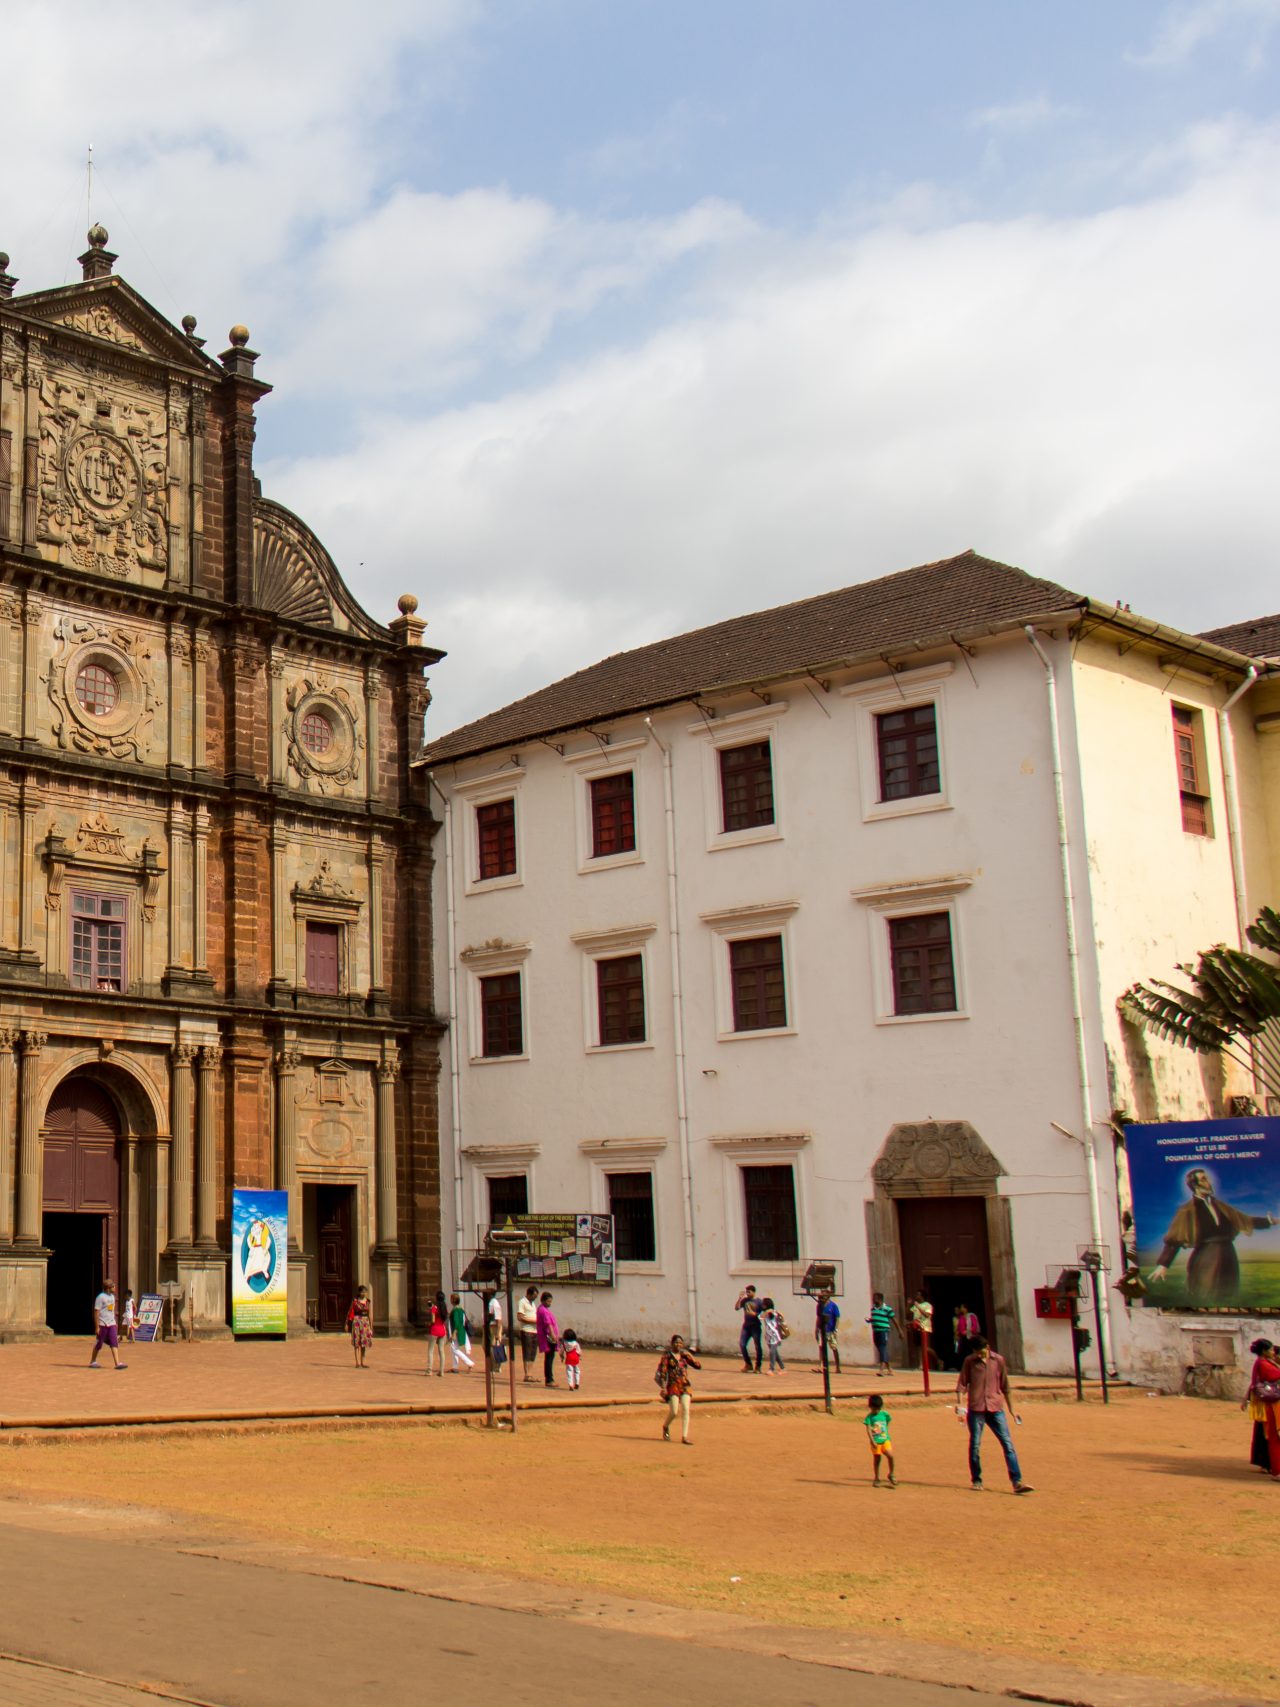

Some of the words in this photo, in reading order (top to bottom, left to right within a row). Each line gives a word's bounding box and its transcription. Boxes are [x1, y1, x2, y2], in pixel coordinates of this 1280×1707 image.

[84, 453, 126, 499] IHS
[1157, 1137, 1199, 1145] HONOURING
[1210, 1134, 1238, 1142] FRANCIS
[1165, 1154, 1203, 1162] FOUNTAINS
[1214, 1152, 1235, 1160] GOD'S
